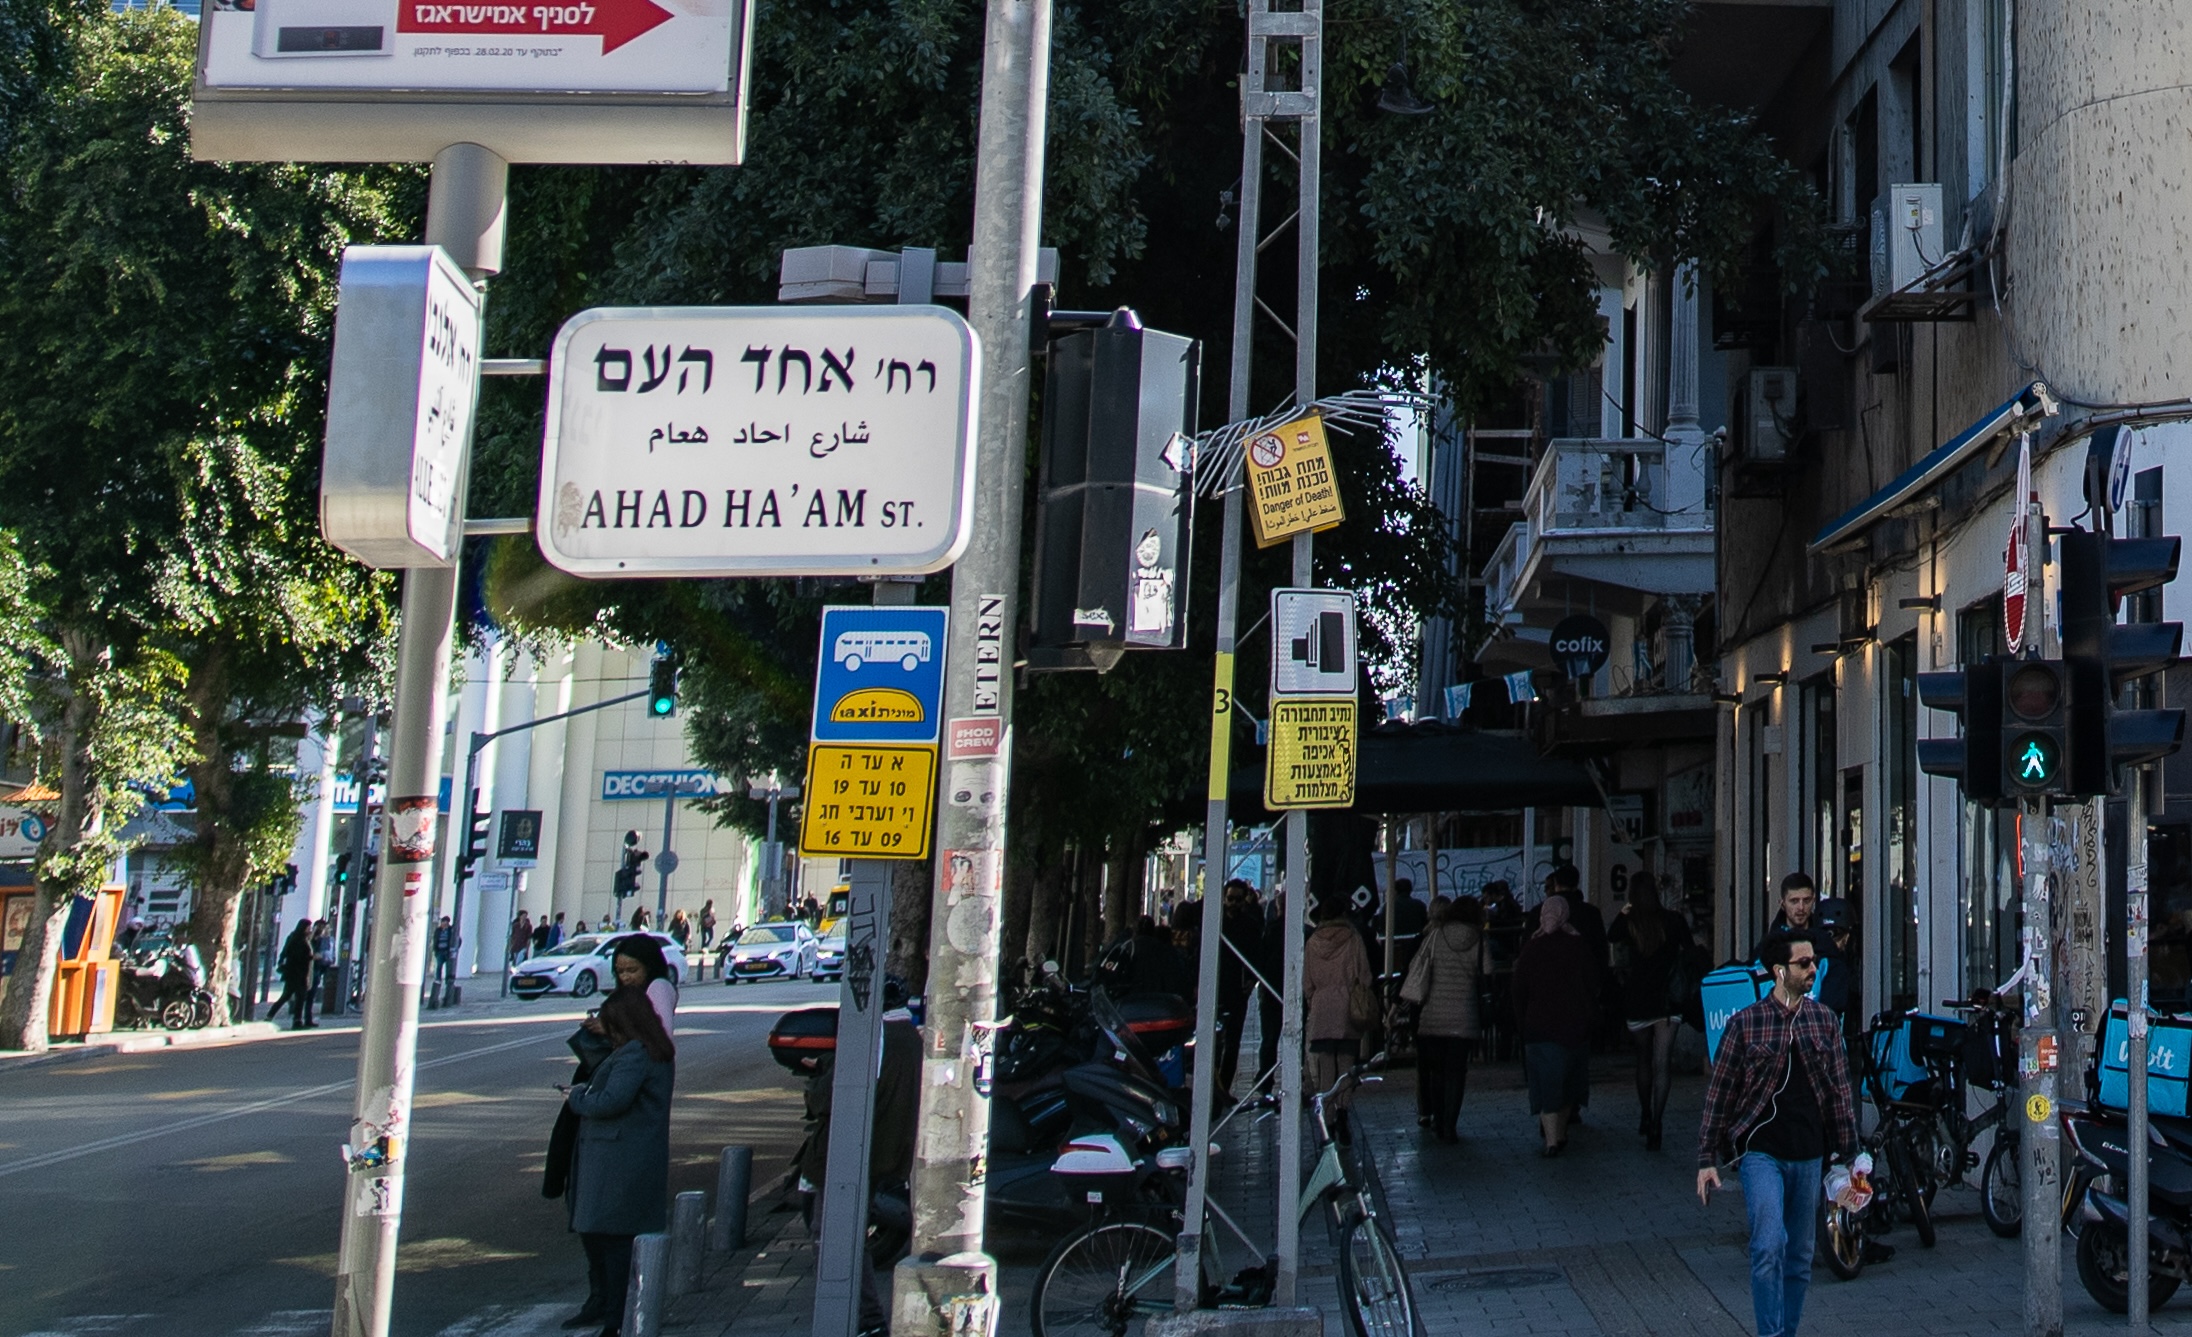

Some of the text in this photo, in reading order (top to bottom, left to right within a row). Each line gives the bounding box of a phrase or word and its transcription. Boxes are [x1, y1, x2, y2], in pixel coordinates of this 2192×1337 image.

[415, 2, 596, 30] לסניף אמישראגז
[516, 48, 528, 57] עד
[593, 343, 937, 396] רח' אחד העם
[649, 420, 871, 458] شارع احاد هعام
[1257, 456, 1326, 486] מתח גבוה!
[1259, 470, 1329, 501] סכנת מוות!
[581, 483, 924, 529] AHAD HA'AM ST.
[1263, 486, 1333, 515] Danger of Death!
[1555, 635, 1603, 653] cofix
[975, 598, 1001, 711] ETERN
[840, 700, 916, 718] taxi מונית
[1215, 688, 1230, 714] 3
[1281, 707, 1352, 722] נתיב תחבורה
[956, 727, 994, 739] #HOD
[954, 737, 995, 749] CREW
[1302, 745, 1335, 760] אכיפה
[840, 754, 904, 771] א עד ה
[1290, 763, 1342, 780] באמצעות
[833, 779, 906, 796] 10 עד 19
[1295, 779, 1338, 798] מצלמות
[818, 804, 840, 820] חג
[848, 805, 894, 821] וערבי
[825, 830, 902, 847] 09 עד 16
[1611, 864, 1628, 893] 6
[2033, 1147, 2046, 1168] Hi
